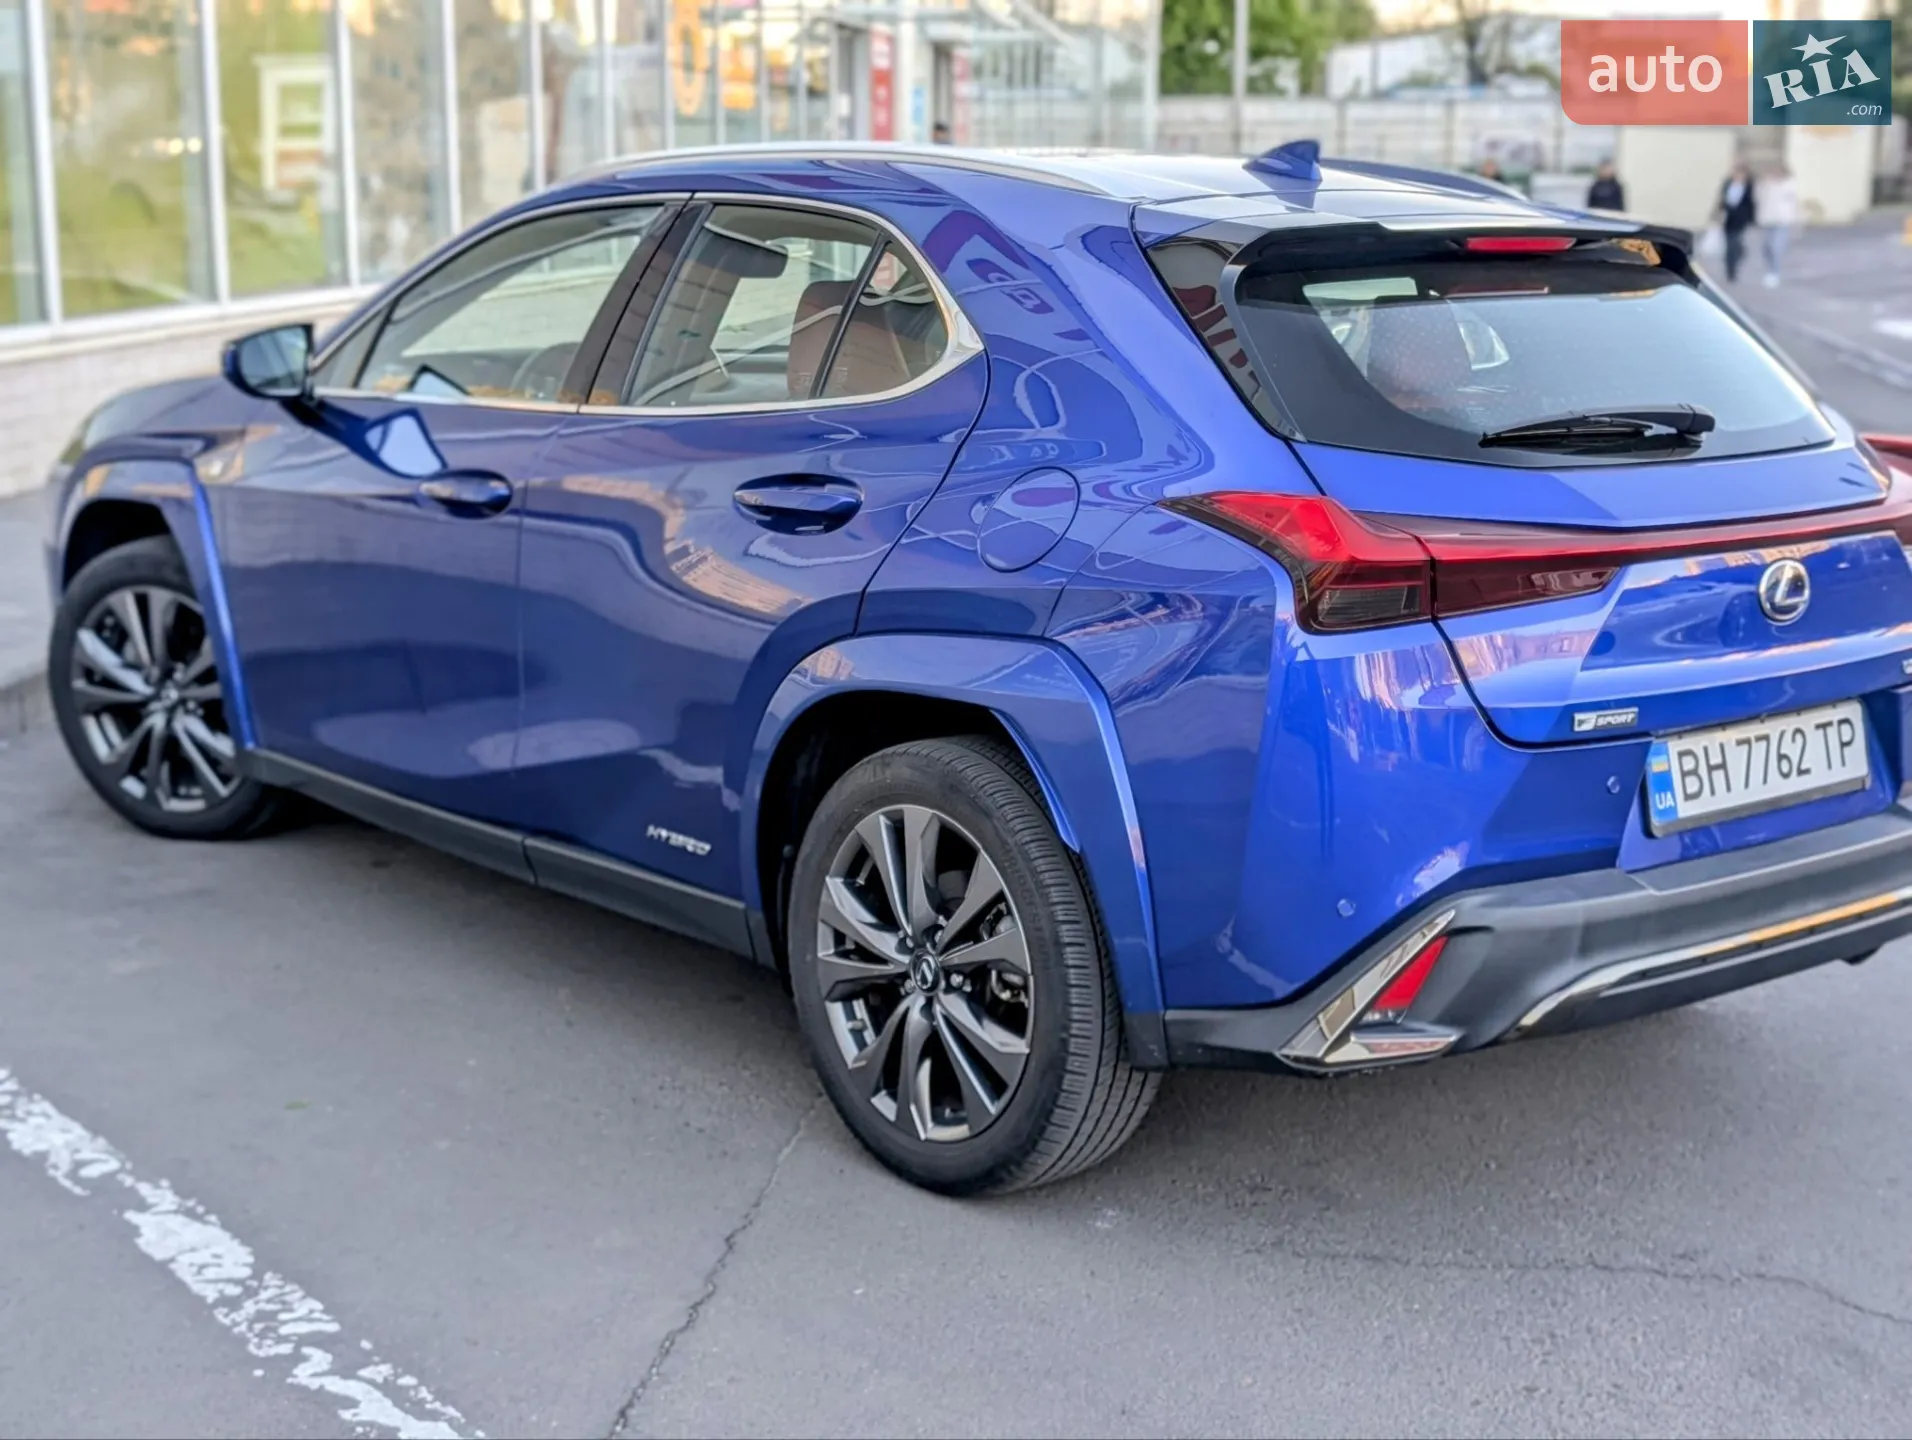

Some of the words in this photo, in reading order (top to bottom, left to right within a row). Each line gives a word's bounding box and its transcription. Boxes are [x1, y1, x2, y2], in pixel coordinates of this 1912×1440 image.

[1596, 711, 1636, 727] SPORT
[1676, 742, 1733, 803] BH
[1735, 727, 1812, 790] 7762
[1814, 716, 1856, 771] TP
[1655, 791, 1675, 810] UA
